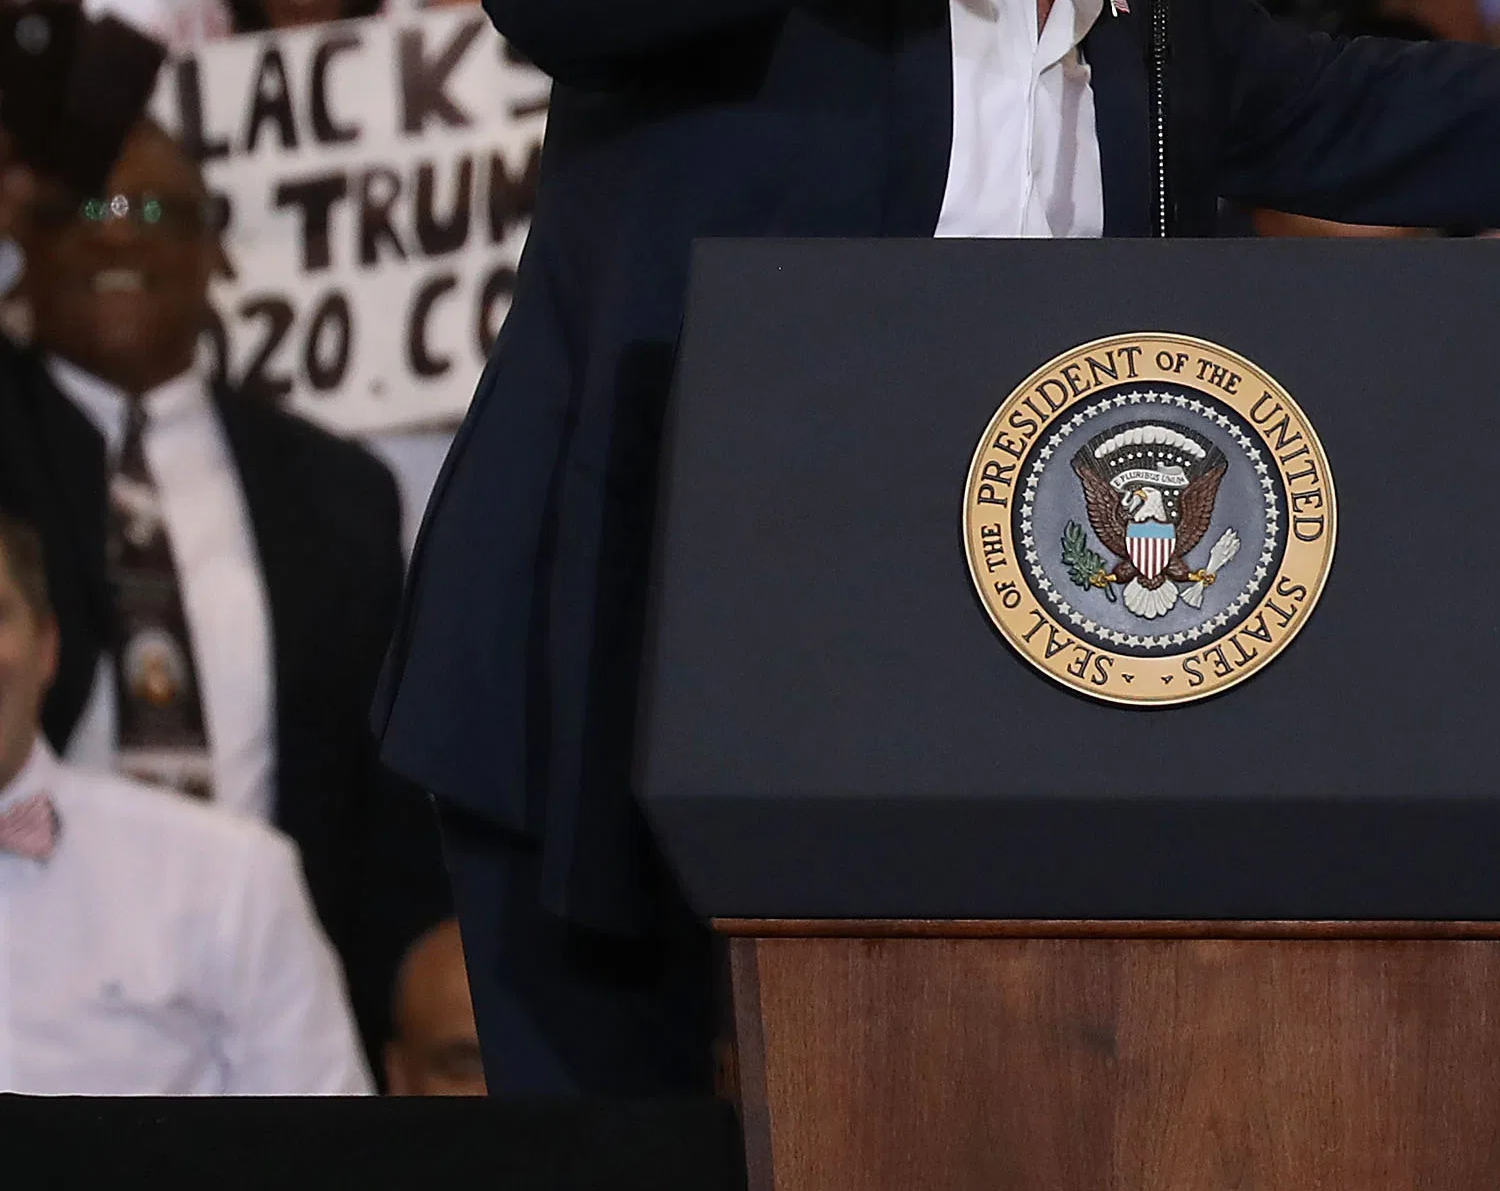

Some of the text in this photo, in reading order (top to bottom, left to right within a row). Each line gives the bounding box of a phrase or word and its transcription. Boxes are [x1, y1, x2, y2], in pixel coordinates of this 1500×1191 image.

[276, 137, 544, 273] TRUM
[978, 346, 1325, 687] SEAL OF THE PRESIDENT OF THE UNITED STATES
